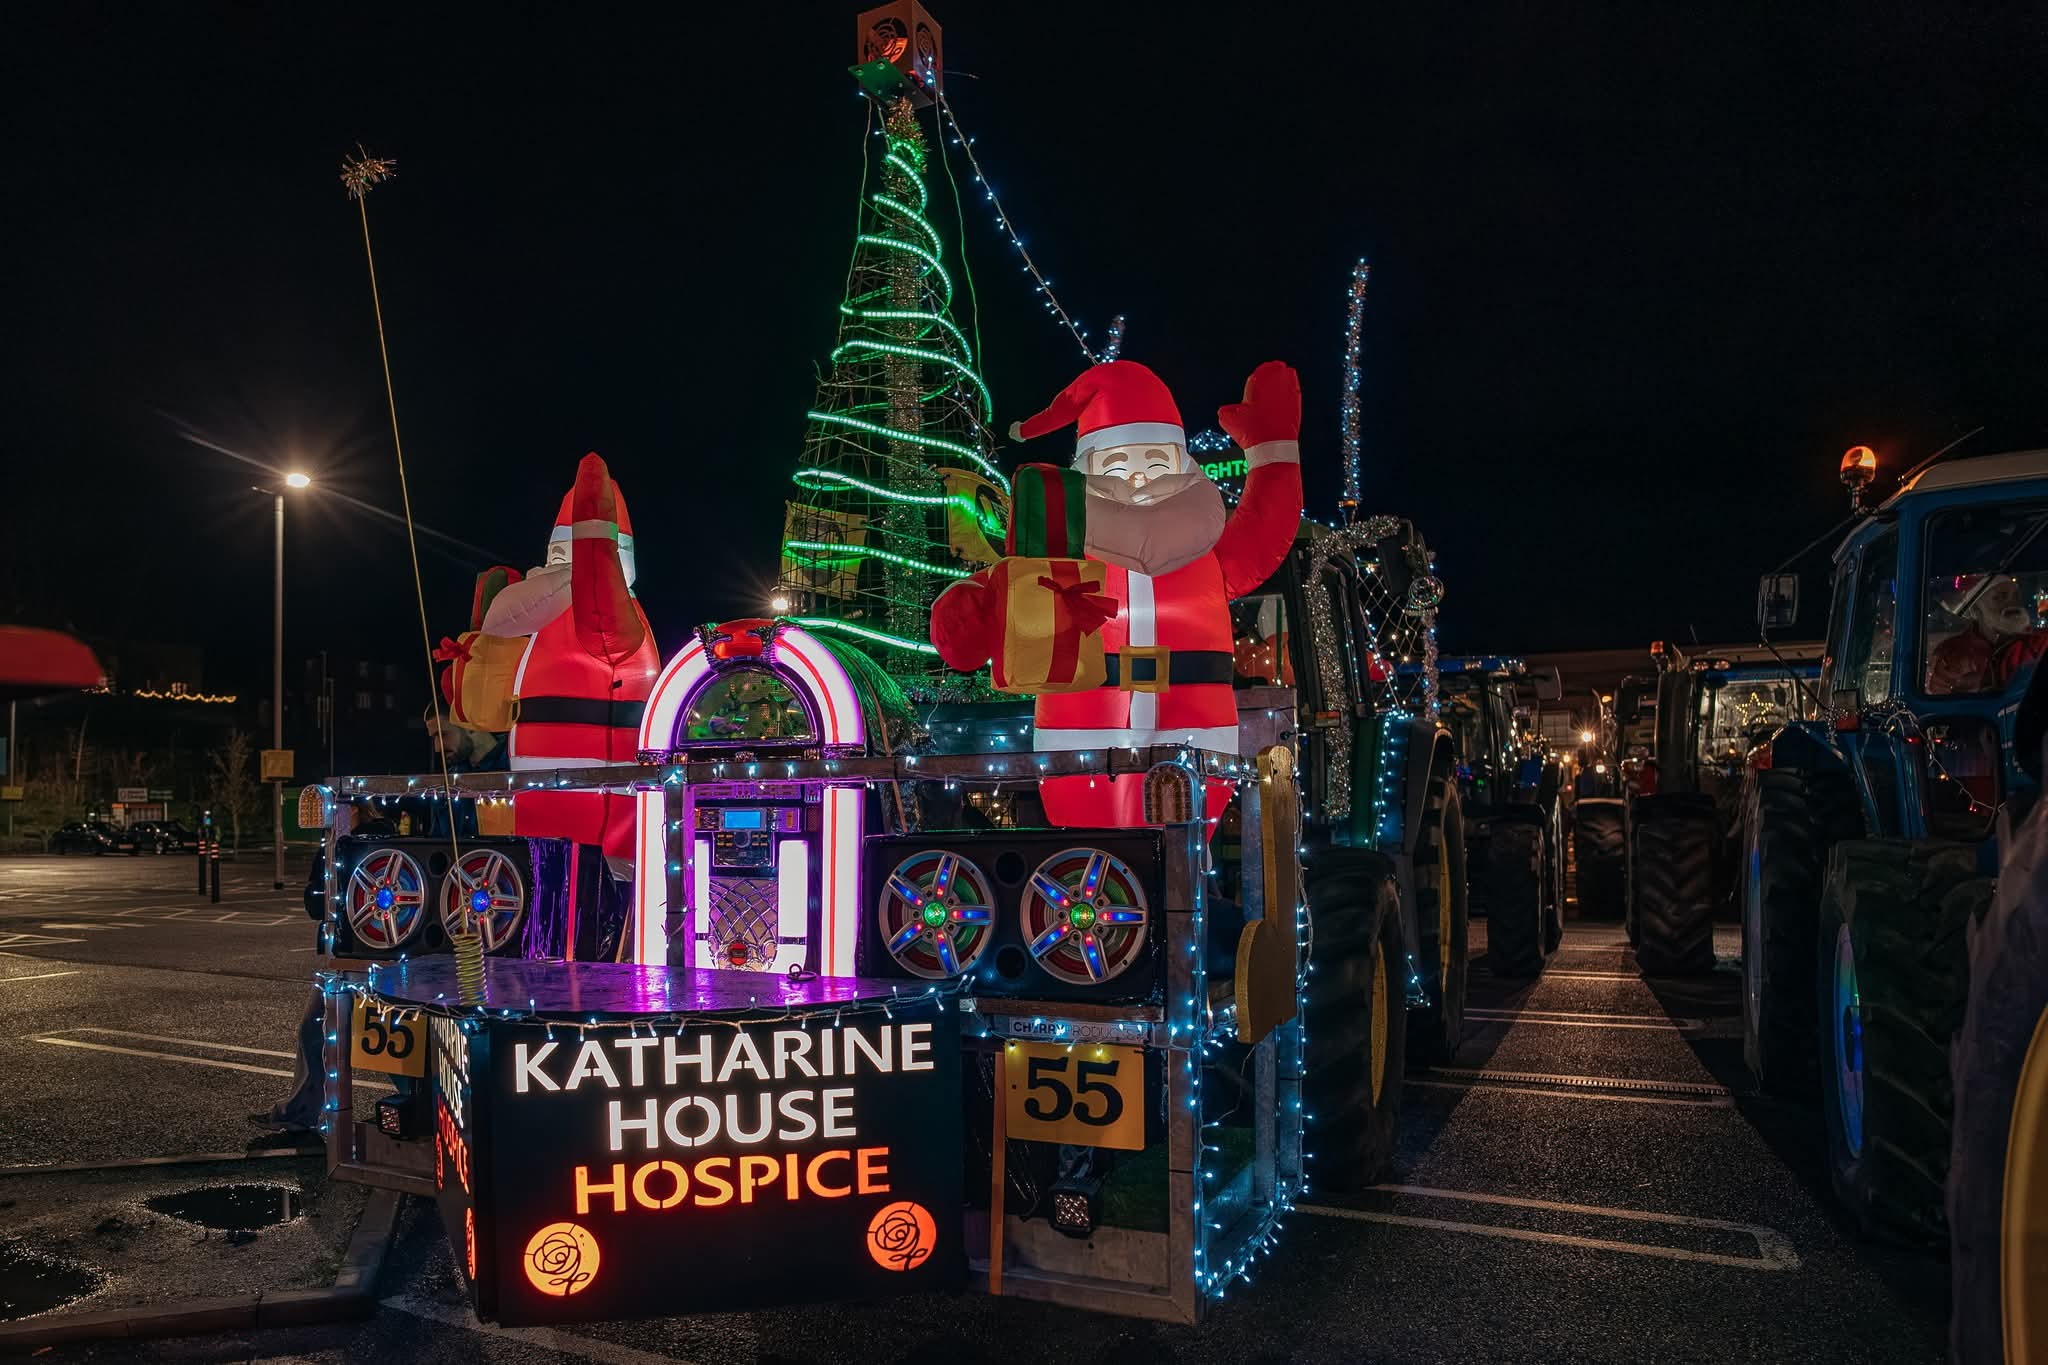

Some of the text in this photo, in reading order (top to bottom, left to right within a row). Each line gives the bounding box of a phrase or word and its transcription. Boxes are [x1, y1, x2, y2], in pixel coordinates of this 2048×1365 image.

[361, 1006, 415, 1058] 55
[515, 1023, 935, 1093] KATHARINE
[438, 1047, 464, 1129] HOUSE
[609, 1087, 857, 1151] HOUSE
[1024, 1056, 1124, 1126] 55
[575, 1147, 890, 1215] HOSPICE
